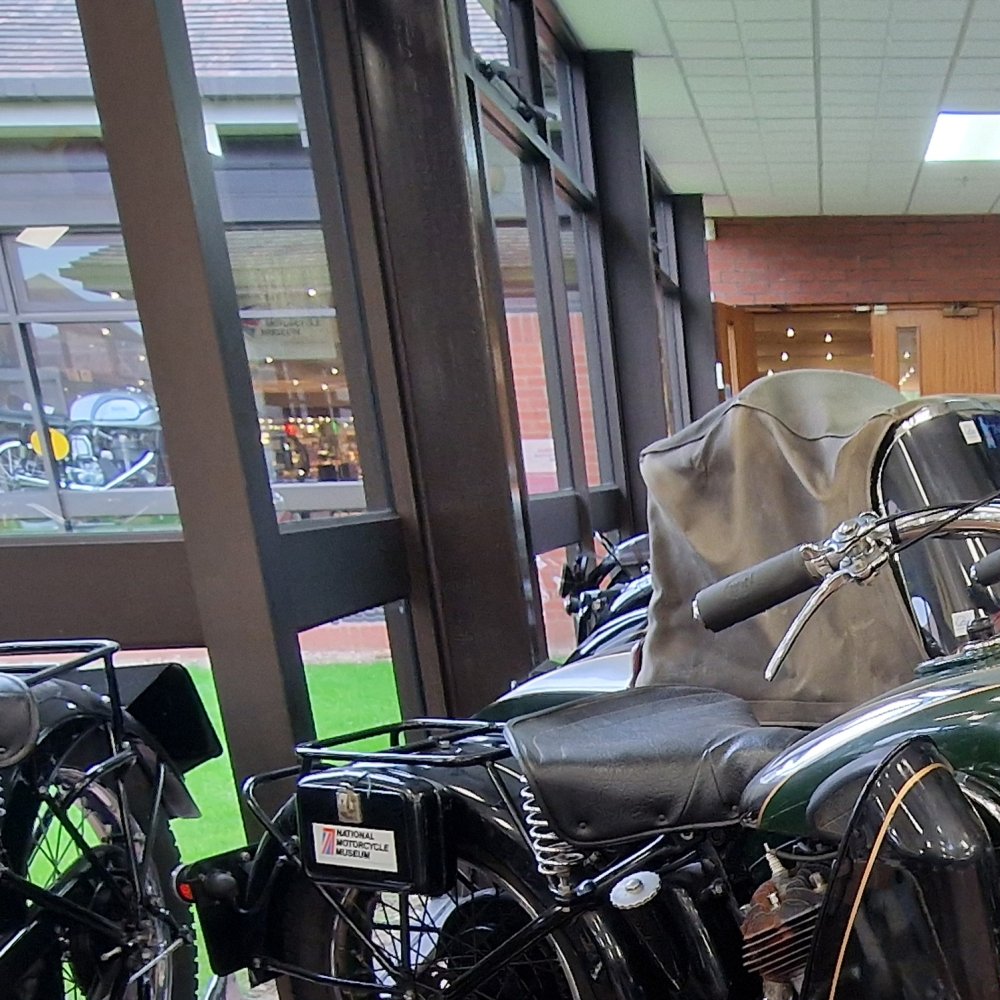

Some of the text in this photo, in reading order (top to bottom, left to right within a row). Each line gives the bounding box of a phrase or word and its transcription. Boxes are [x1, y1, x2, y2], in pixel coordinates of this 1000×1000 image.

[337, 829, 375, 840] NATIONAL
[336, 839, 390, 852] MOTORCYCLE
[336, 848, 371, 859] MUSEUM
